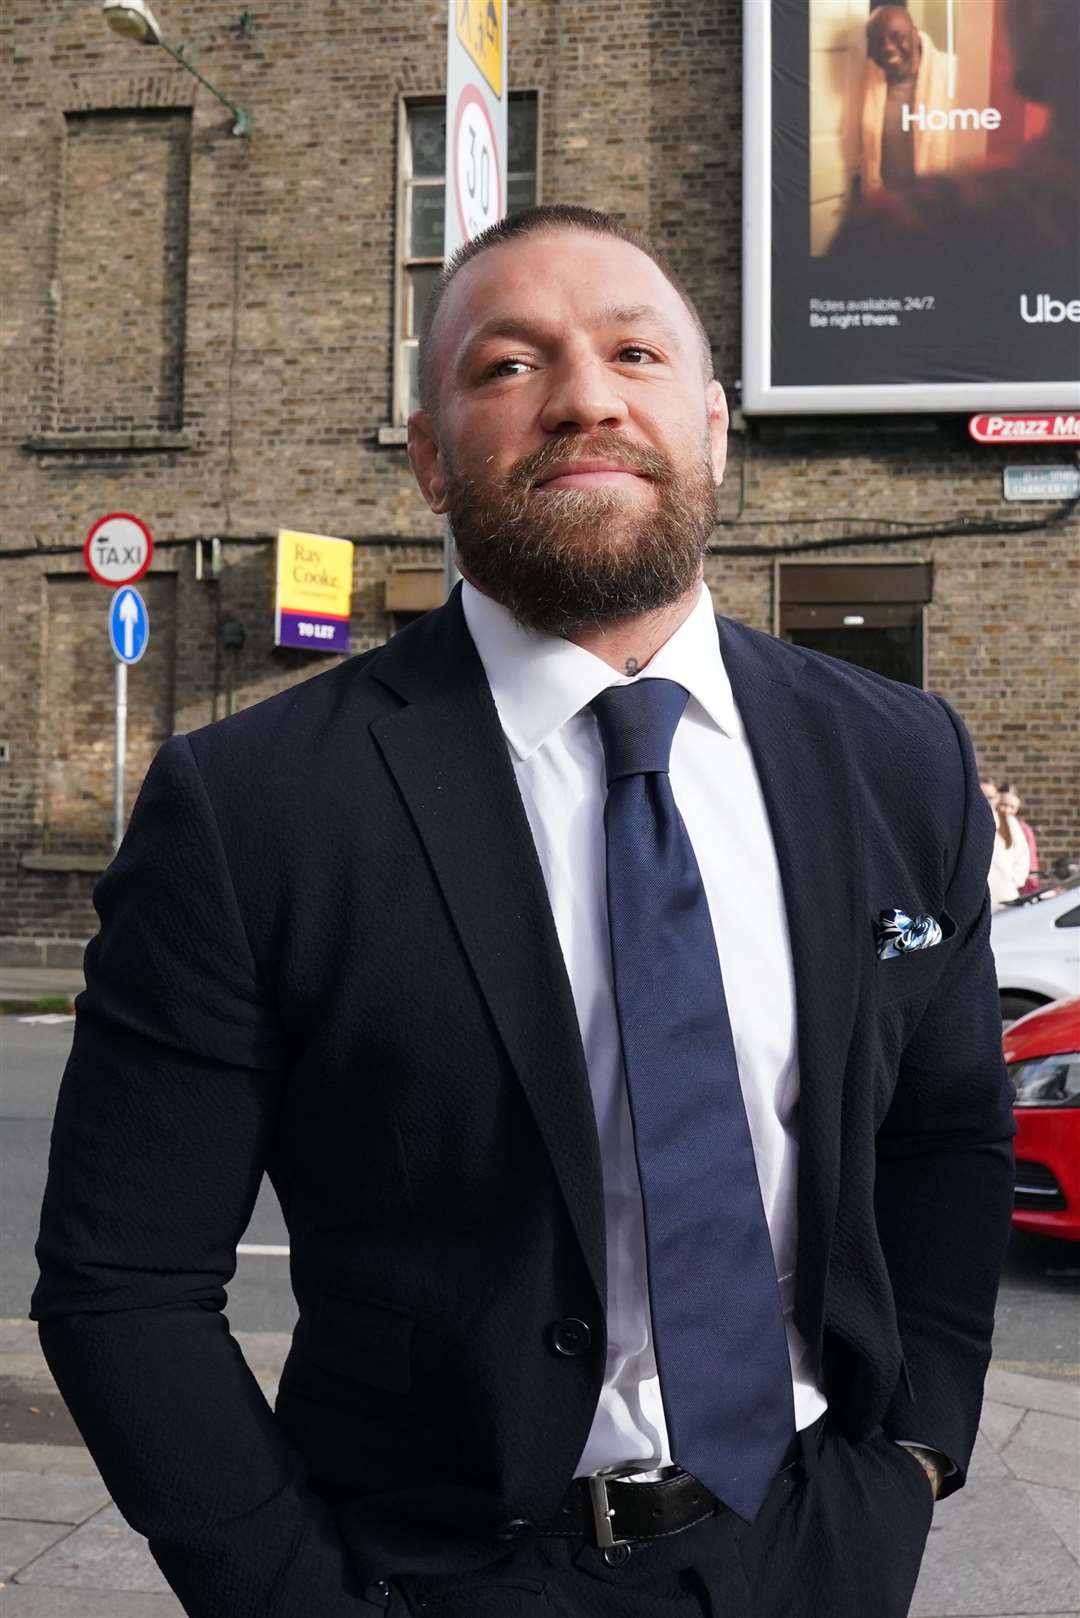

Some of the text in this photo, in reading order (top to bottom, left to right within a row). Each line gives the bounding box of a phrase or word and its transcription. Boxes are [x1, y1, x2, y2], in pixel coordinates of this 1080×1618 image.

[901, 103, 1002, 132] Home
[466, 124, 490, 216] 30
[809, 298, 845, 312] Rides
[809, 313, 829, 327] Be
[830, 314, 860, 330] right
[986, 417, 1049, 436] Pzazz
[96, 546, 141, 565] TAXI
[294, 544, 321, 566] Ray
[292, 566, 339, 588] Cooke
[298, 622, 314, 637] TO
